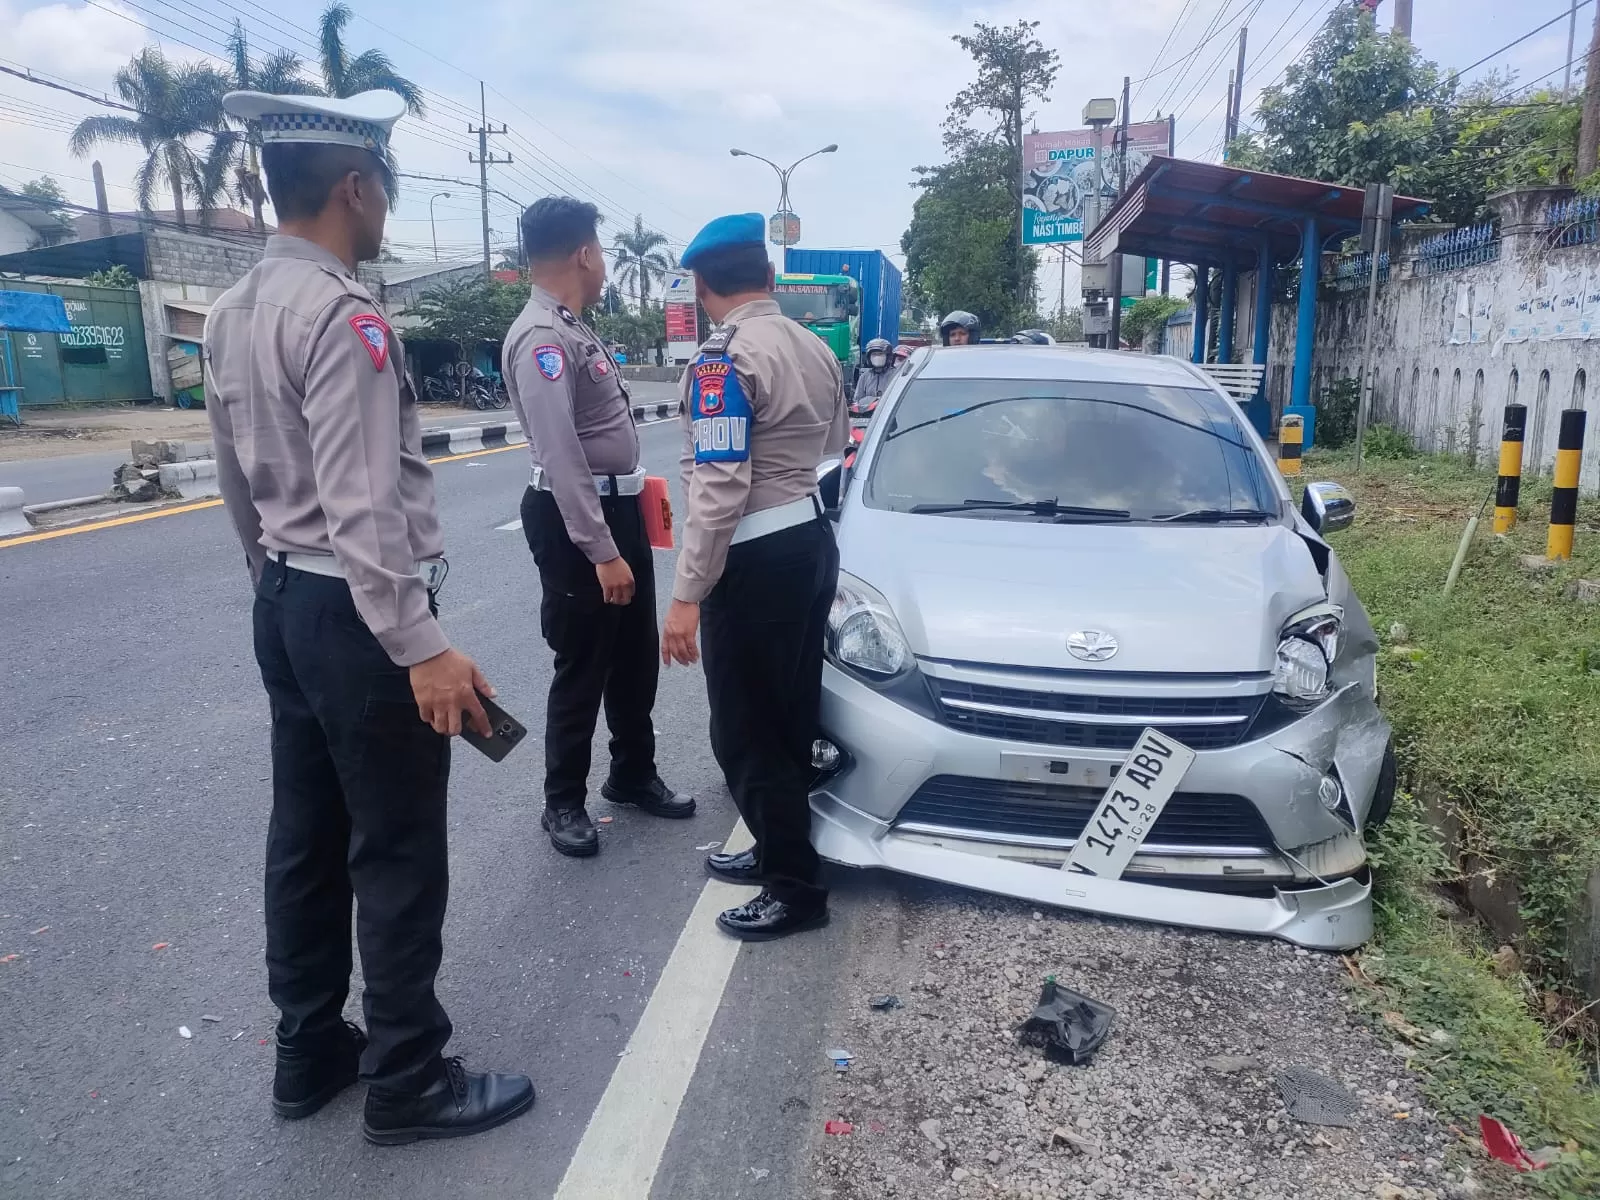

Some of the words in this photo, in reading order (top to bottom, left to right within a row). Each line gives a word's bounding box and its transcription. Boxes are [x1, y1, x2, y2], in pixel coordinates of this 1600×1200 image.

[1048, 148, 1095, 161] DAPUR
[1032, 223, 1054, 237] NASI
[788, 285, 828, 295] NUSANTARA
[692, 417, 747, 454] PROV
[1085, 789, 1140, 857] 1473
[1124, 735, 1173, 790] ABV
